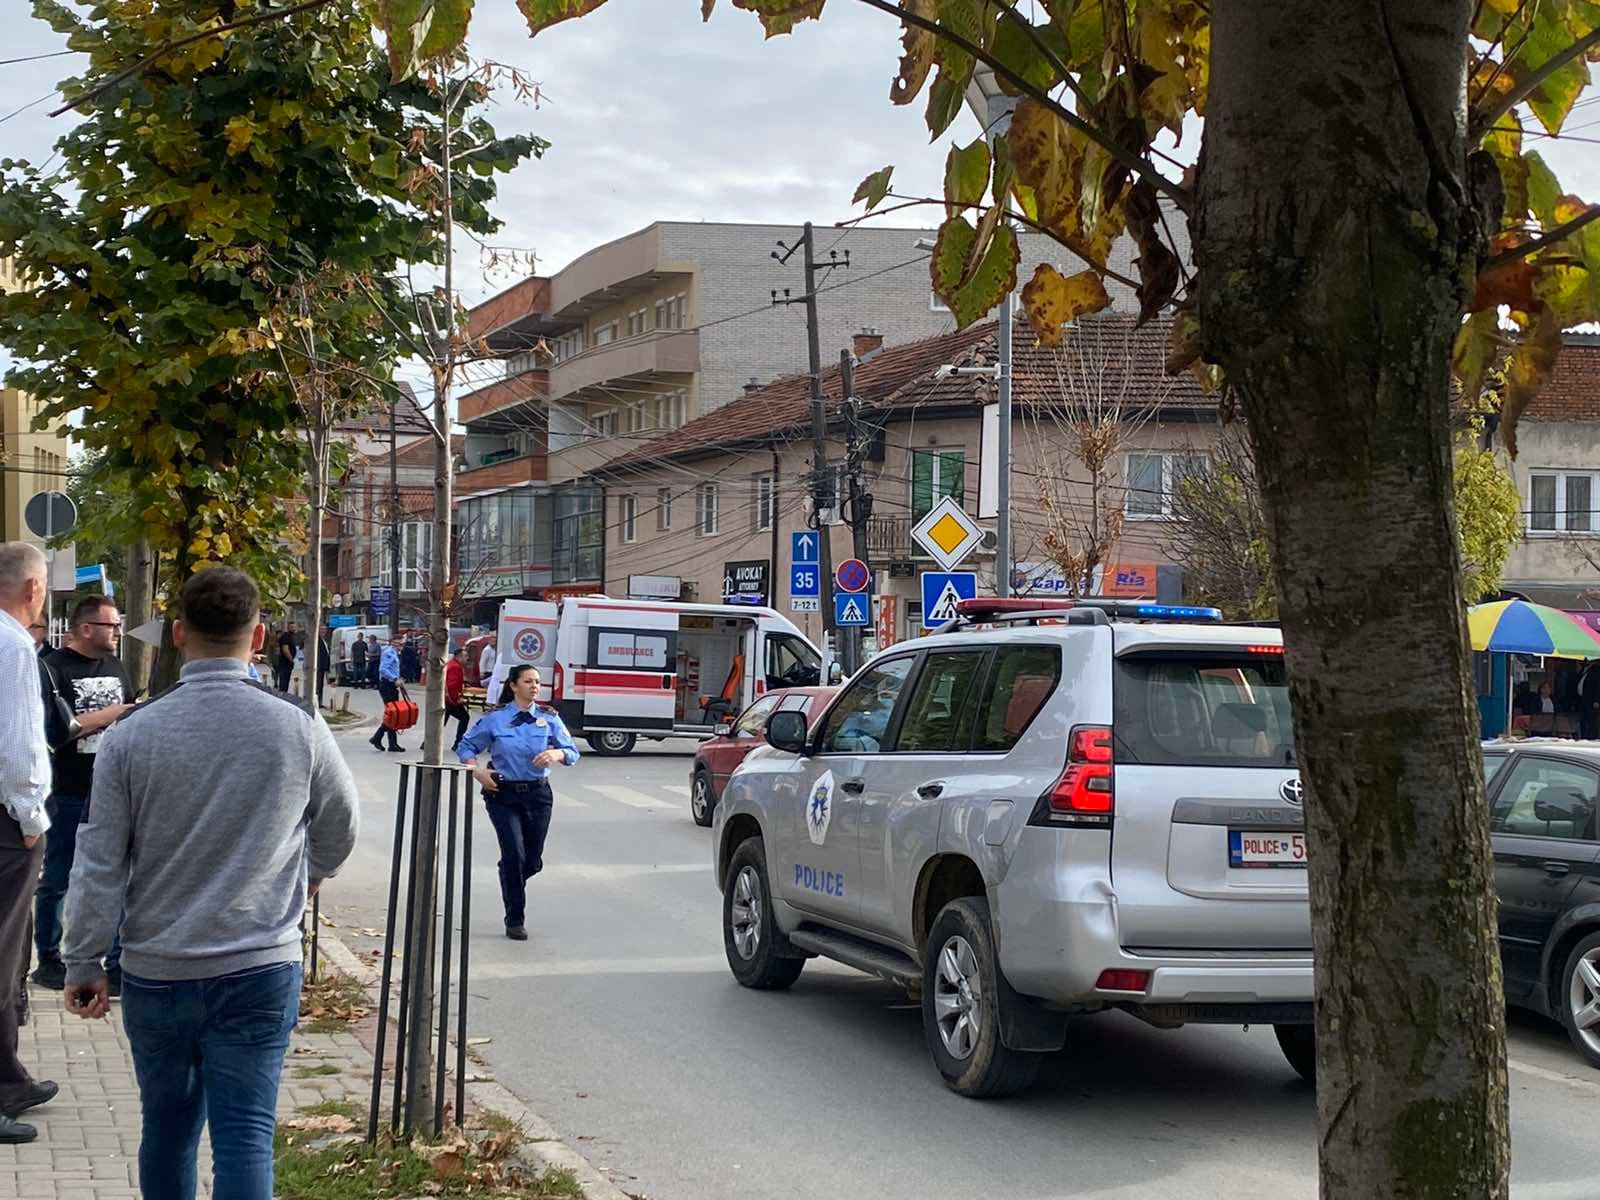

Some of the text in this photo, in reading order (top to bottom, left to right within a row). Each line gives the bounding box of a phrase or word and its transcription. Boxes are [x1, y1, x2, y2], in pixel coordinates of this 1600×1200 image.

[736, 566, 763, 580] AVOKAT
[795, 572, 814, 588] 35
[1116, 571, 1145, 586] Ria
[793, 601, 810, 609] 7-12
[607, 646, 655, 657] AMBULANCE
[1243, 835, 1308, 859] POLICE 5
[794, 864, 844, 896] POLICE
